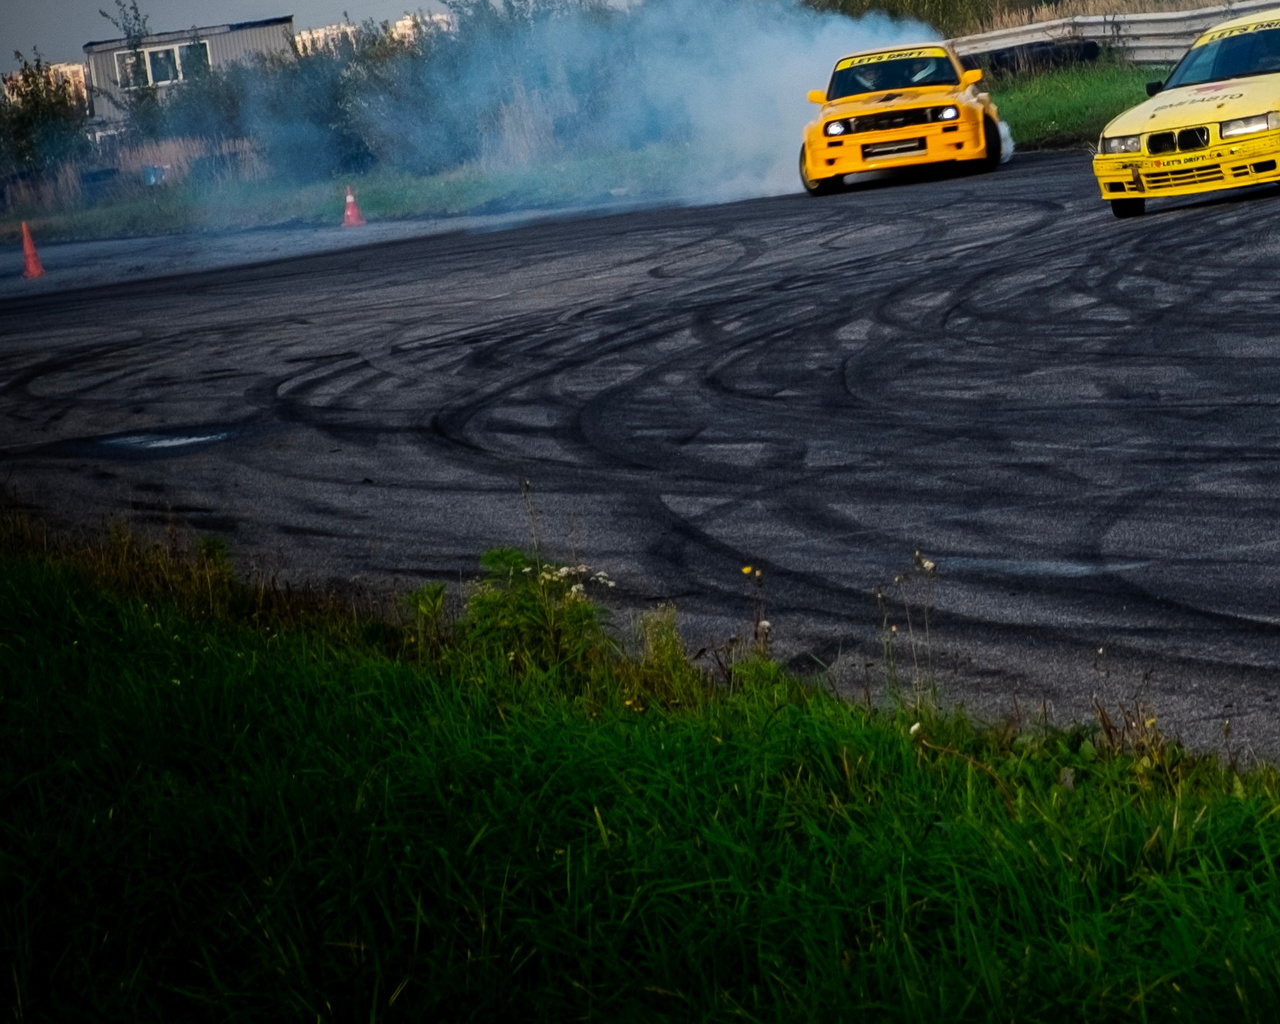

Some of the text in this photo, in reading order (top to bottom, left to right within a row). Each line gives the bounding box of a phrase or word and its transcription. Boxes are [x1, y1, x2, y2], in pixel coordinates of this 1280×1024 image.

[1209, 26, 1248, 41] LET'S
[850, 55, 883, 66] LET'S
[1162, 159, 1182, 167] LET'S
[1184, 154, 1206, 163] DRIFT
